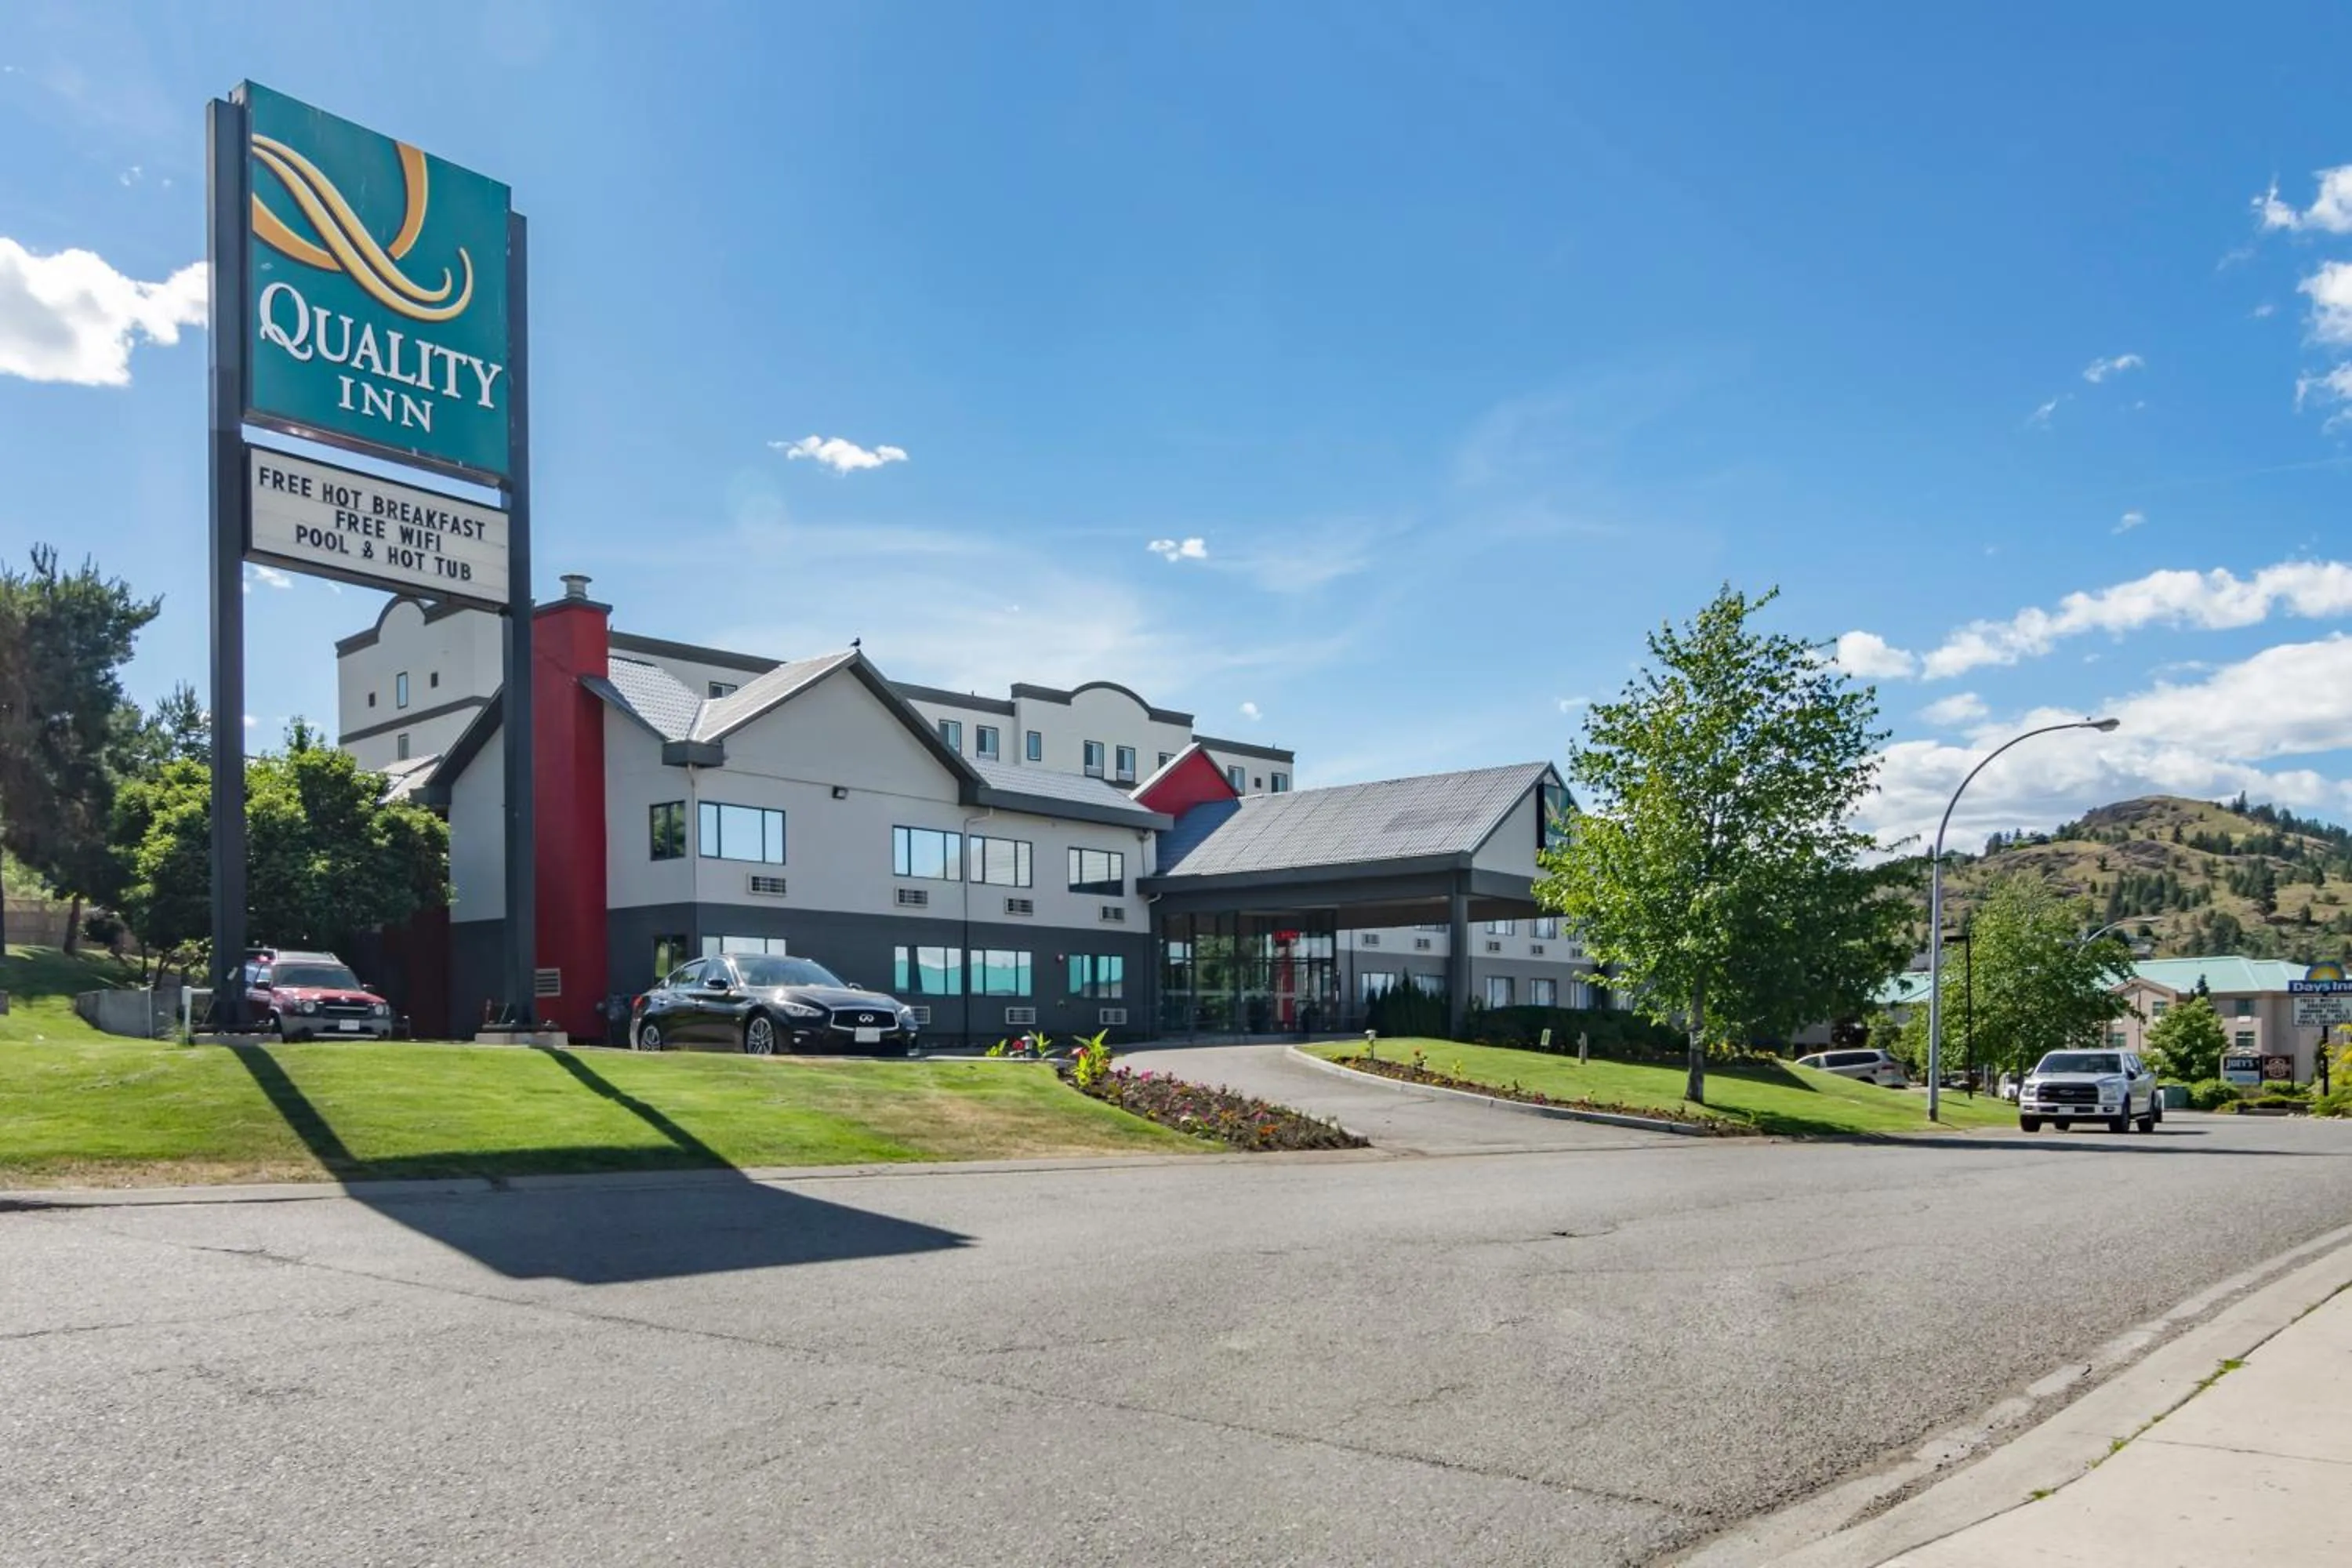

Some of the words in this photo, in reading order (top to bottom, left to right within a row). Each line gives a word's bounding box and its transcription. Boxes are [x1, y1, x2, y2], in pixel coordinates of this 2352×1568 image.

[260, 282, 503, 408] QUALITY
[339, 375, 434, 433] INN
[260, 466, 312, 497] FREE
[322, 482, 362, 509] HOT
[372, 495, 485, 540] BREAKFAST
[336, 510, 386, 539] FREE
[400, 524, 441, 552] WIFI
[296, 524, 349, 554] POOL
[362, 540, 374, 559] &
[388, 545, 425, 571] HOT
[434, 556, 471, 581] TUB
[2293, 982, 2331, 993] Days
